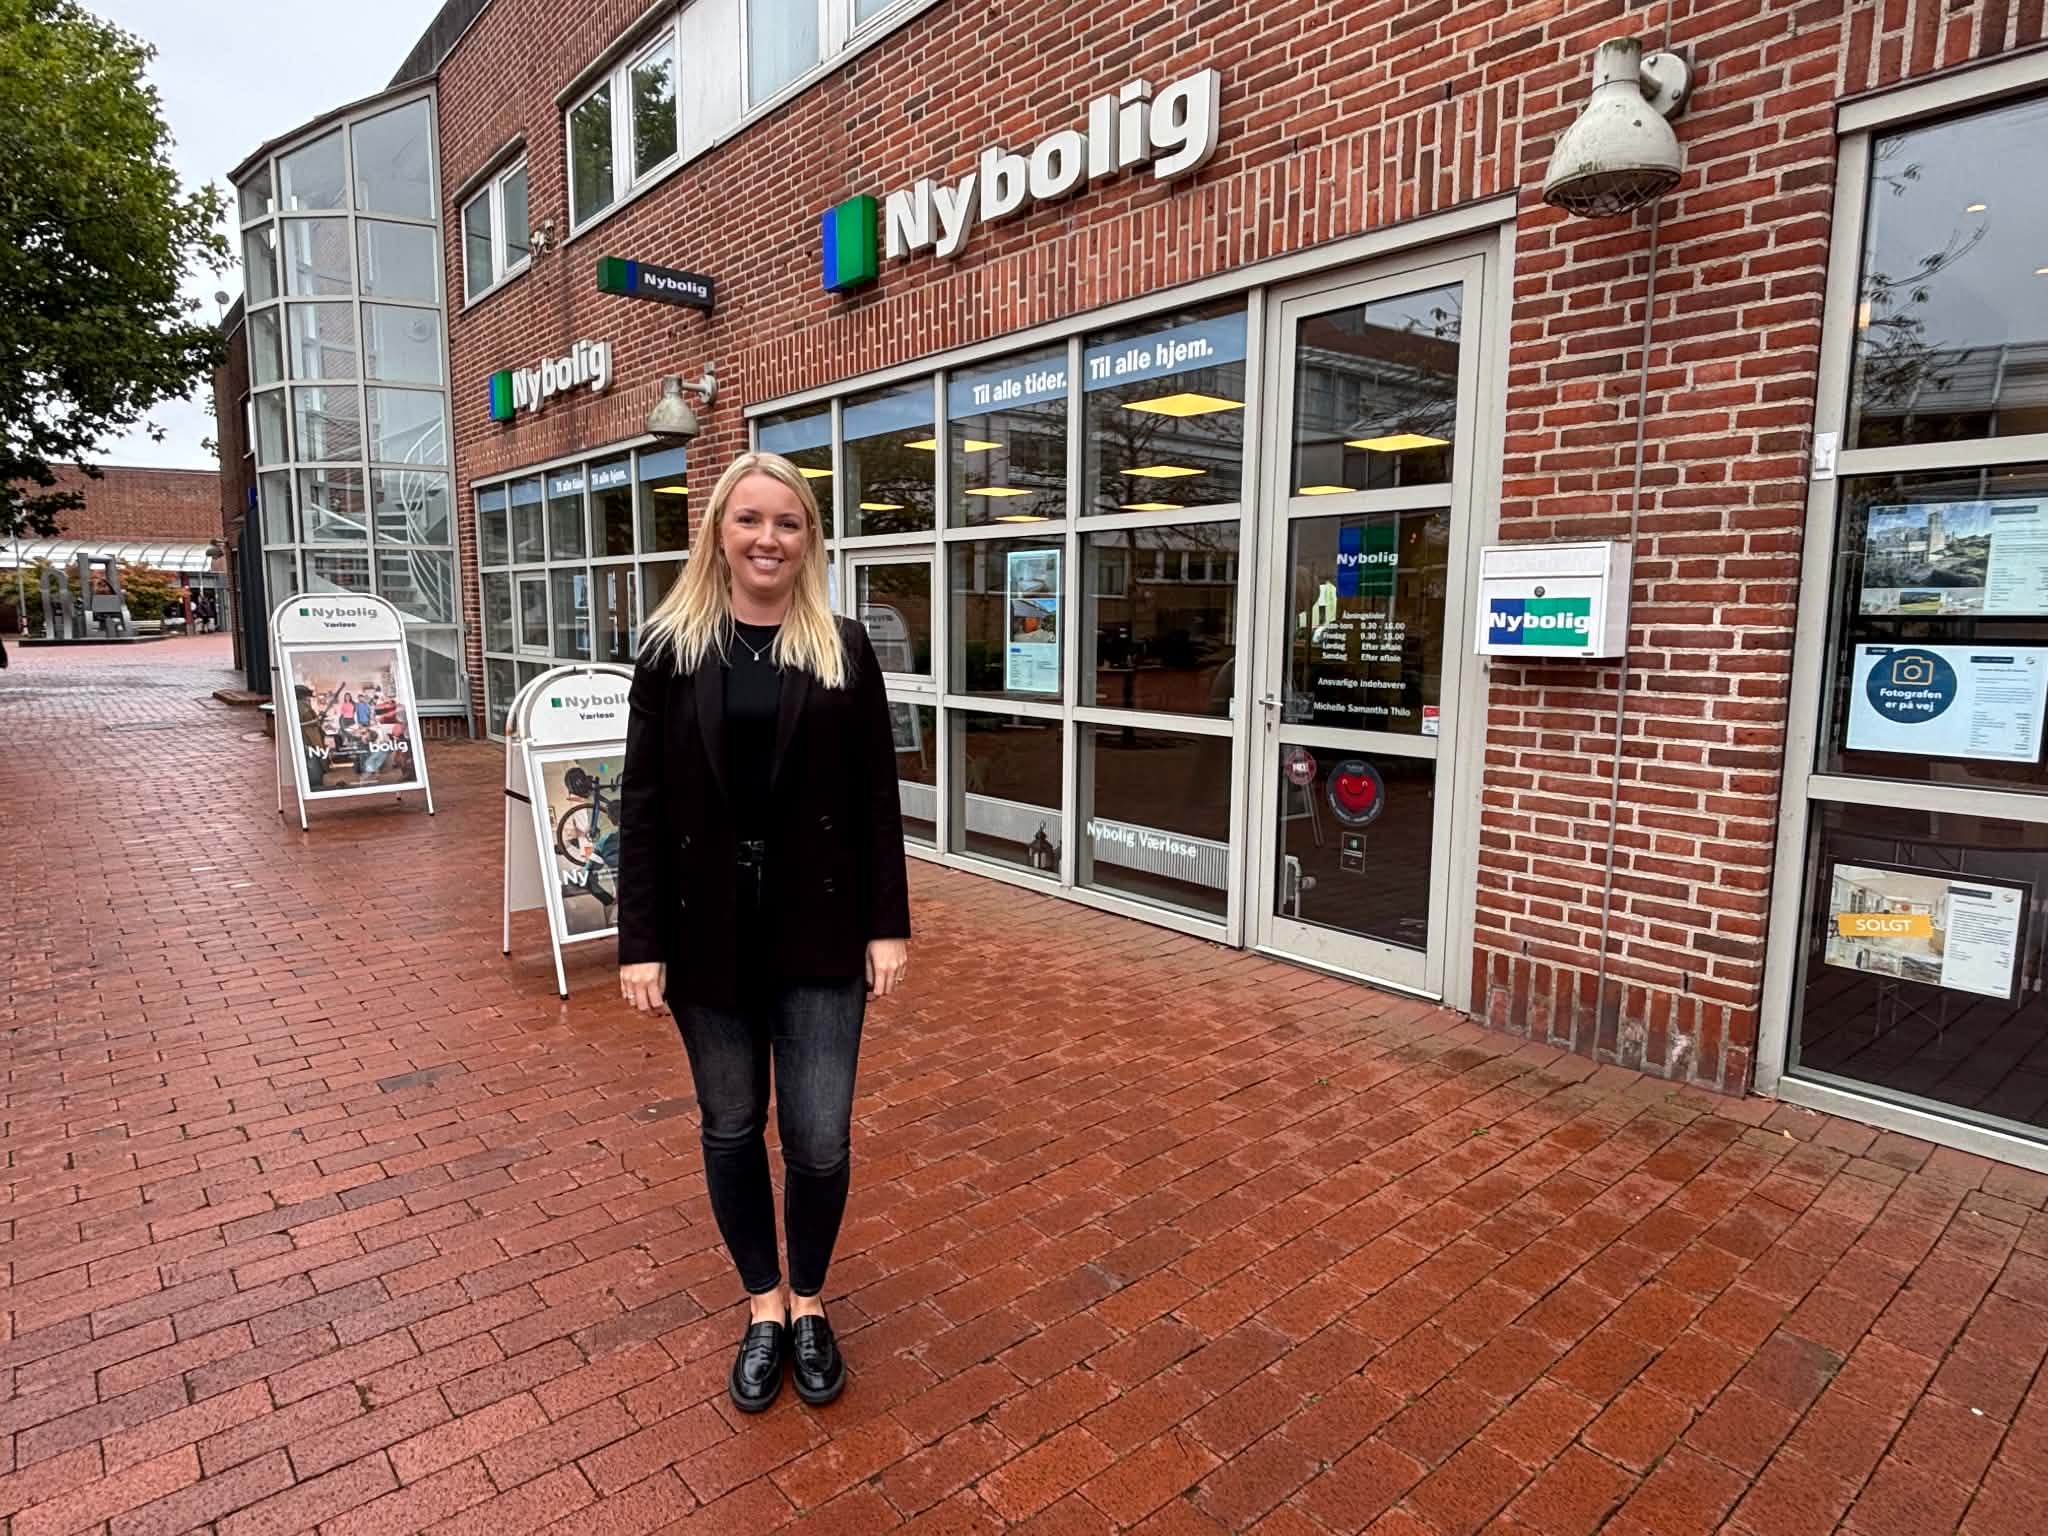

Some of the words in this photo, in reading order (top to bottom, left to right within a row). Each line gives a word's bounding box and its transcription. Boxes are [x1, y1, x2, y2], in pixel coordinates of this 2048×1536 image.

[885, 68, 1221, 259] Nybolig
[644, 273, 707, 298] Nybolig
[1090, 355, 1110, 380] Til
[1116, 349, 1151, 375] alle
[1156, 339, 1213, 369] hjem.
[512, 340, 612, 412] Nybolig
[973, 384, 990, 405] Til
[993, 379, 1021, 402] alle
[1024, 371, 1067, 395] tider.
[1337, 551, 1399, 566] Nybolig
[312, 608, 378, 618] Nybolig
[1489, 612, 1592, 634] Nybolig
[1360, 679, 1406, 690] indehavere
[1879, 688, 1942, 700] Fotografen
[1313, 702, 1346, 712] Michelle
[1348, 703, 1388, 716] Samantha
[1899, 700, 1914, 711] på
[1916, 702, 1934, 712] vej
[308, 745, 330, 759] Ny
[369, 739, 408, 752] bolig
[1087, 821, 1136, 848] Nybolig
[1139, 831, 1197, 857] Værløse
[562, 869, 590, 887] Ny
[1855, 919, 1913, 932] SOLGT
